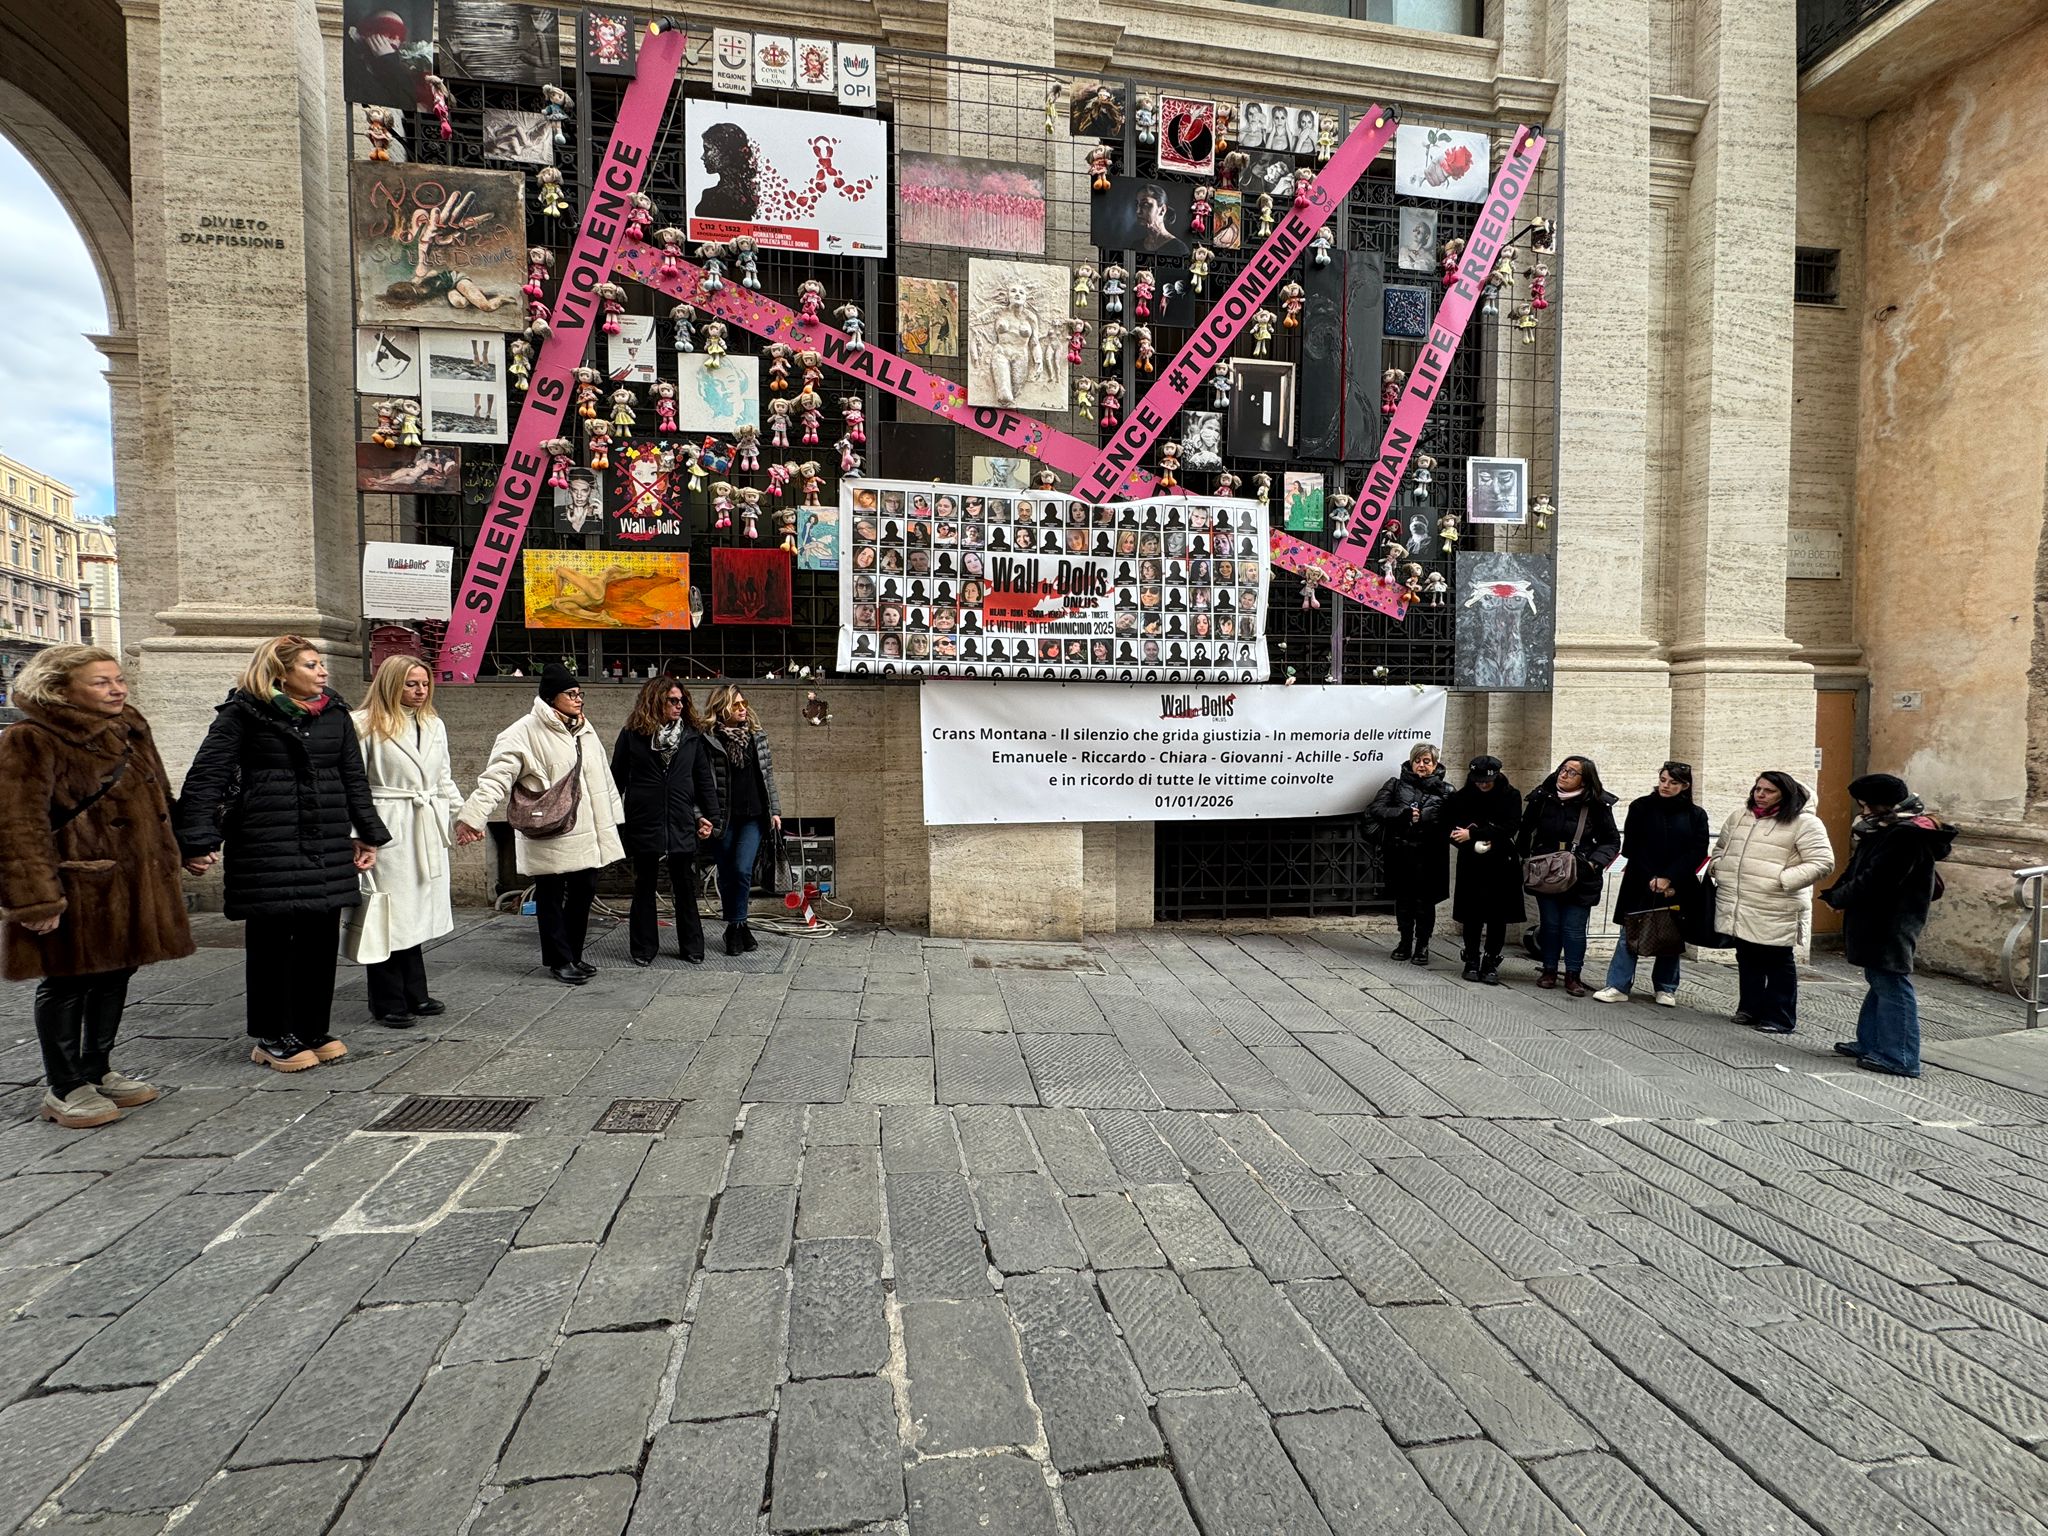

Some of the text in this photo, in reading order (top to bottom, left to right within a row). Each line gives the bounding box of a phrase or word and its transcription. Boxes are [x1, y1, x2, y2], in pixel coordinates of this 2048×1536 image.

[717, 72, 747, 81] REGIONE
[717, 82, 746, 92] LIGURIA
[844, 84, 870, 97] OPI
[370, 177, 446, 209] NO
[1323, 198, 1335, 212] OPI
[200, 216, 268, 231] DIVIETO
[1168, 214, 1311, 395] #TUCOMEME
[1346, 154, 1533, 549] WOMAN LIFE FREEDOM
[464, 140, 642, 614] SILENCE IS VIOLENCE
[822, 333, 1021, 437] WALL OF
[620, 517, 646, 534] Wall
[992, 556, 1039, 594] Wall
[1057, 560, 1107, 597] Dolls
[1063, 596, 1099, 608] ONLUS
[986, 620, 994, 632] LE
[997, 620, 1027, 634] VITTIME
[1030, 622, 1037, 634] DI
[1040, 622, 1092, 635] FEMMINICIDIO
[1093, 622, 1114, 634] 2025
[1161, 695, 1190, 717] Wall
[1201, 695, 1234, 717] Dolls
[1902, 695, 1912, 708] 2
[932, 727, 976, 741] Crans
[980, 727, 1047, 741] Montana
[1073, 727, 1130, 741] silenzio
[1133, 728, 1159, 742] che
[1162, 728, 1199, 745] grida
[1203, 728, 1262, 745] giustizia
[1273, 729, 1286, 742] In
[1290, 728, 1350, 742] memoria
[1353, 728, 1385, 741] delle
[1388, 728, 1432, 740] vittime
[992, 749, 1068, 764] Emanuele
[1081, 750, 1147, 764] Riccardo
[1159, 750, 1208, 764] Chiara
[1220, 750, 1284, 764] Giovanni
[1294, 749, 1342, 763] Achille
[1352, 749, 1384, 762] Sofia
[1048, 771, 1334, 787] e in ricordo di tutte le vittime coinvolte
[1154, 794, 1234, 808] 01/01/2026
